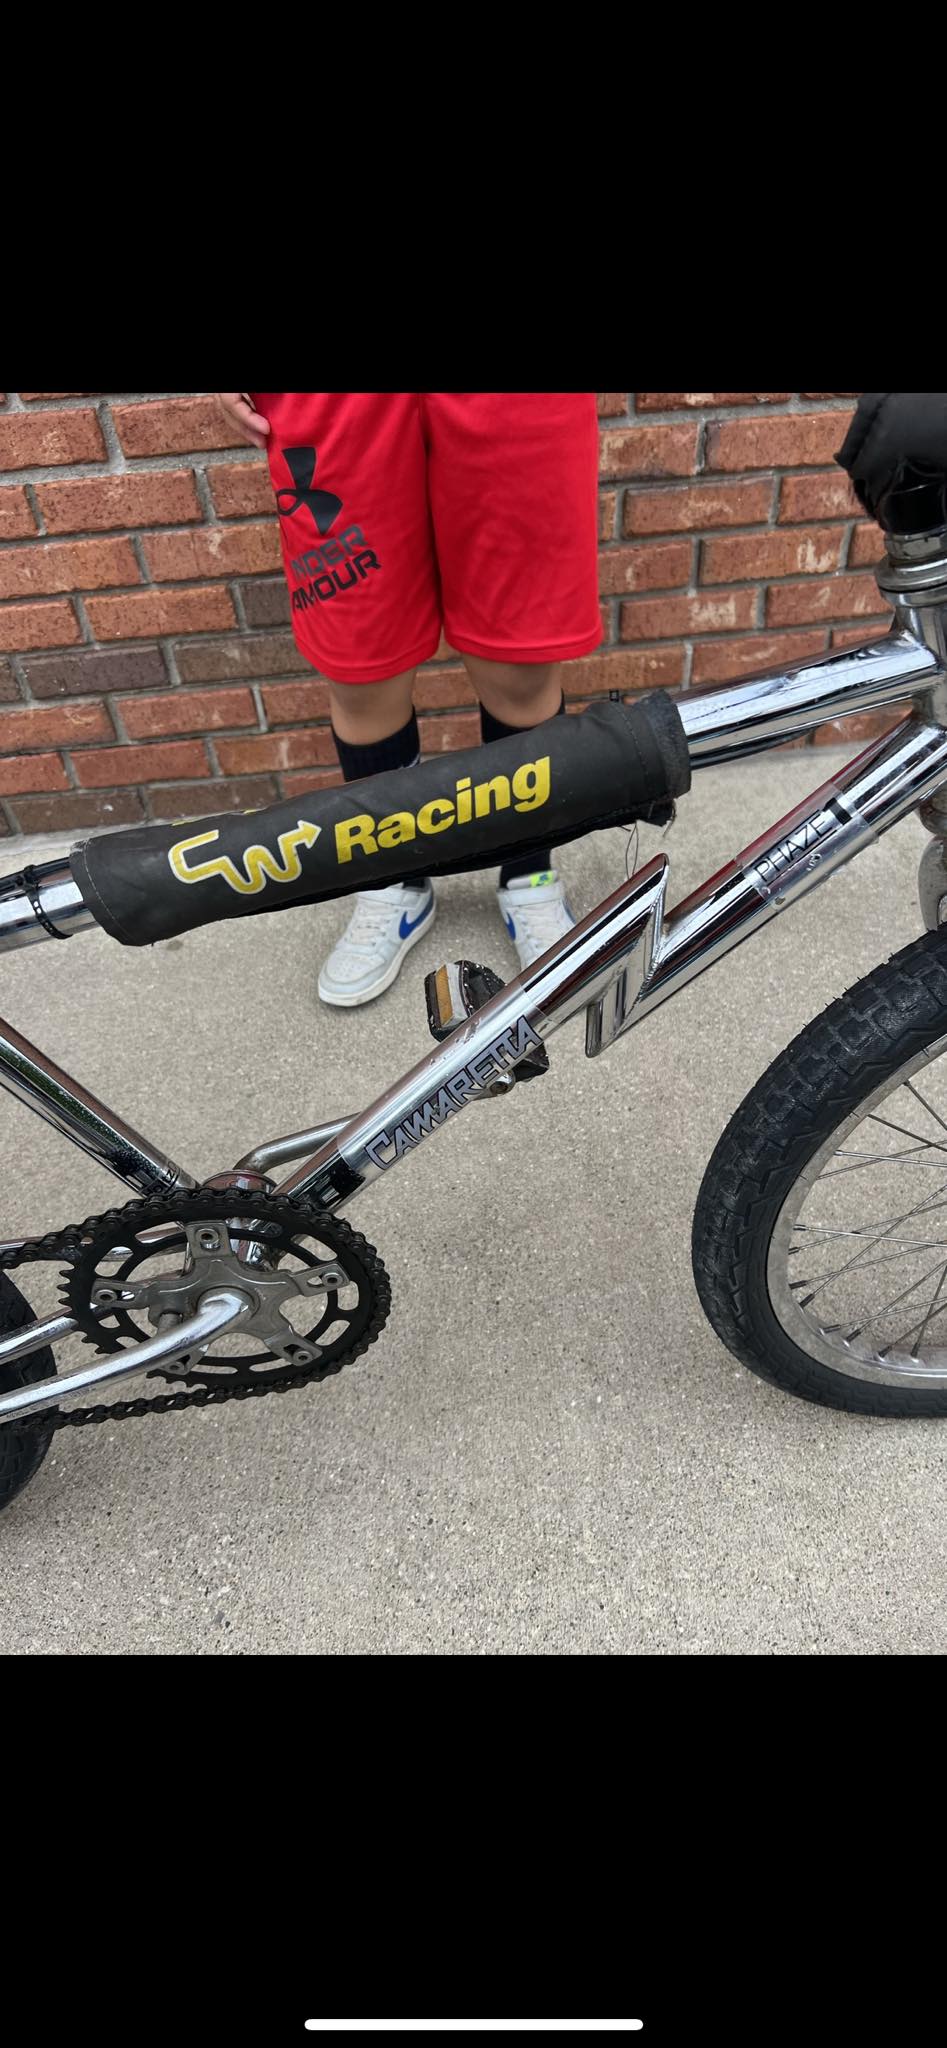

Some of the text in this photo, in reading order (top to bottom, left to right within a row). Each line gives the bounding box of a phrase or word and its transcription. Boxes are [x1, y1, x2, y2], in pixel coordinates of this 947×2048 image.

[291, 524, 368, 577] NDER
[334, 756, 551, 865] Racing
[754, 813, 833, 882] PHAZE
